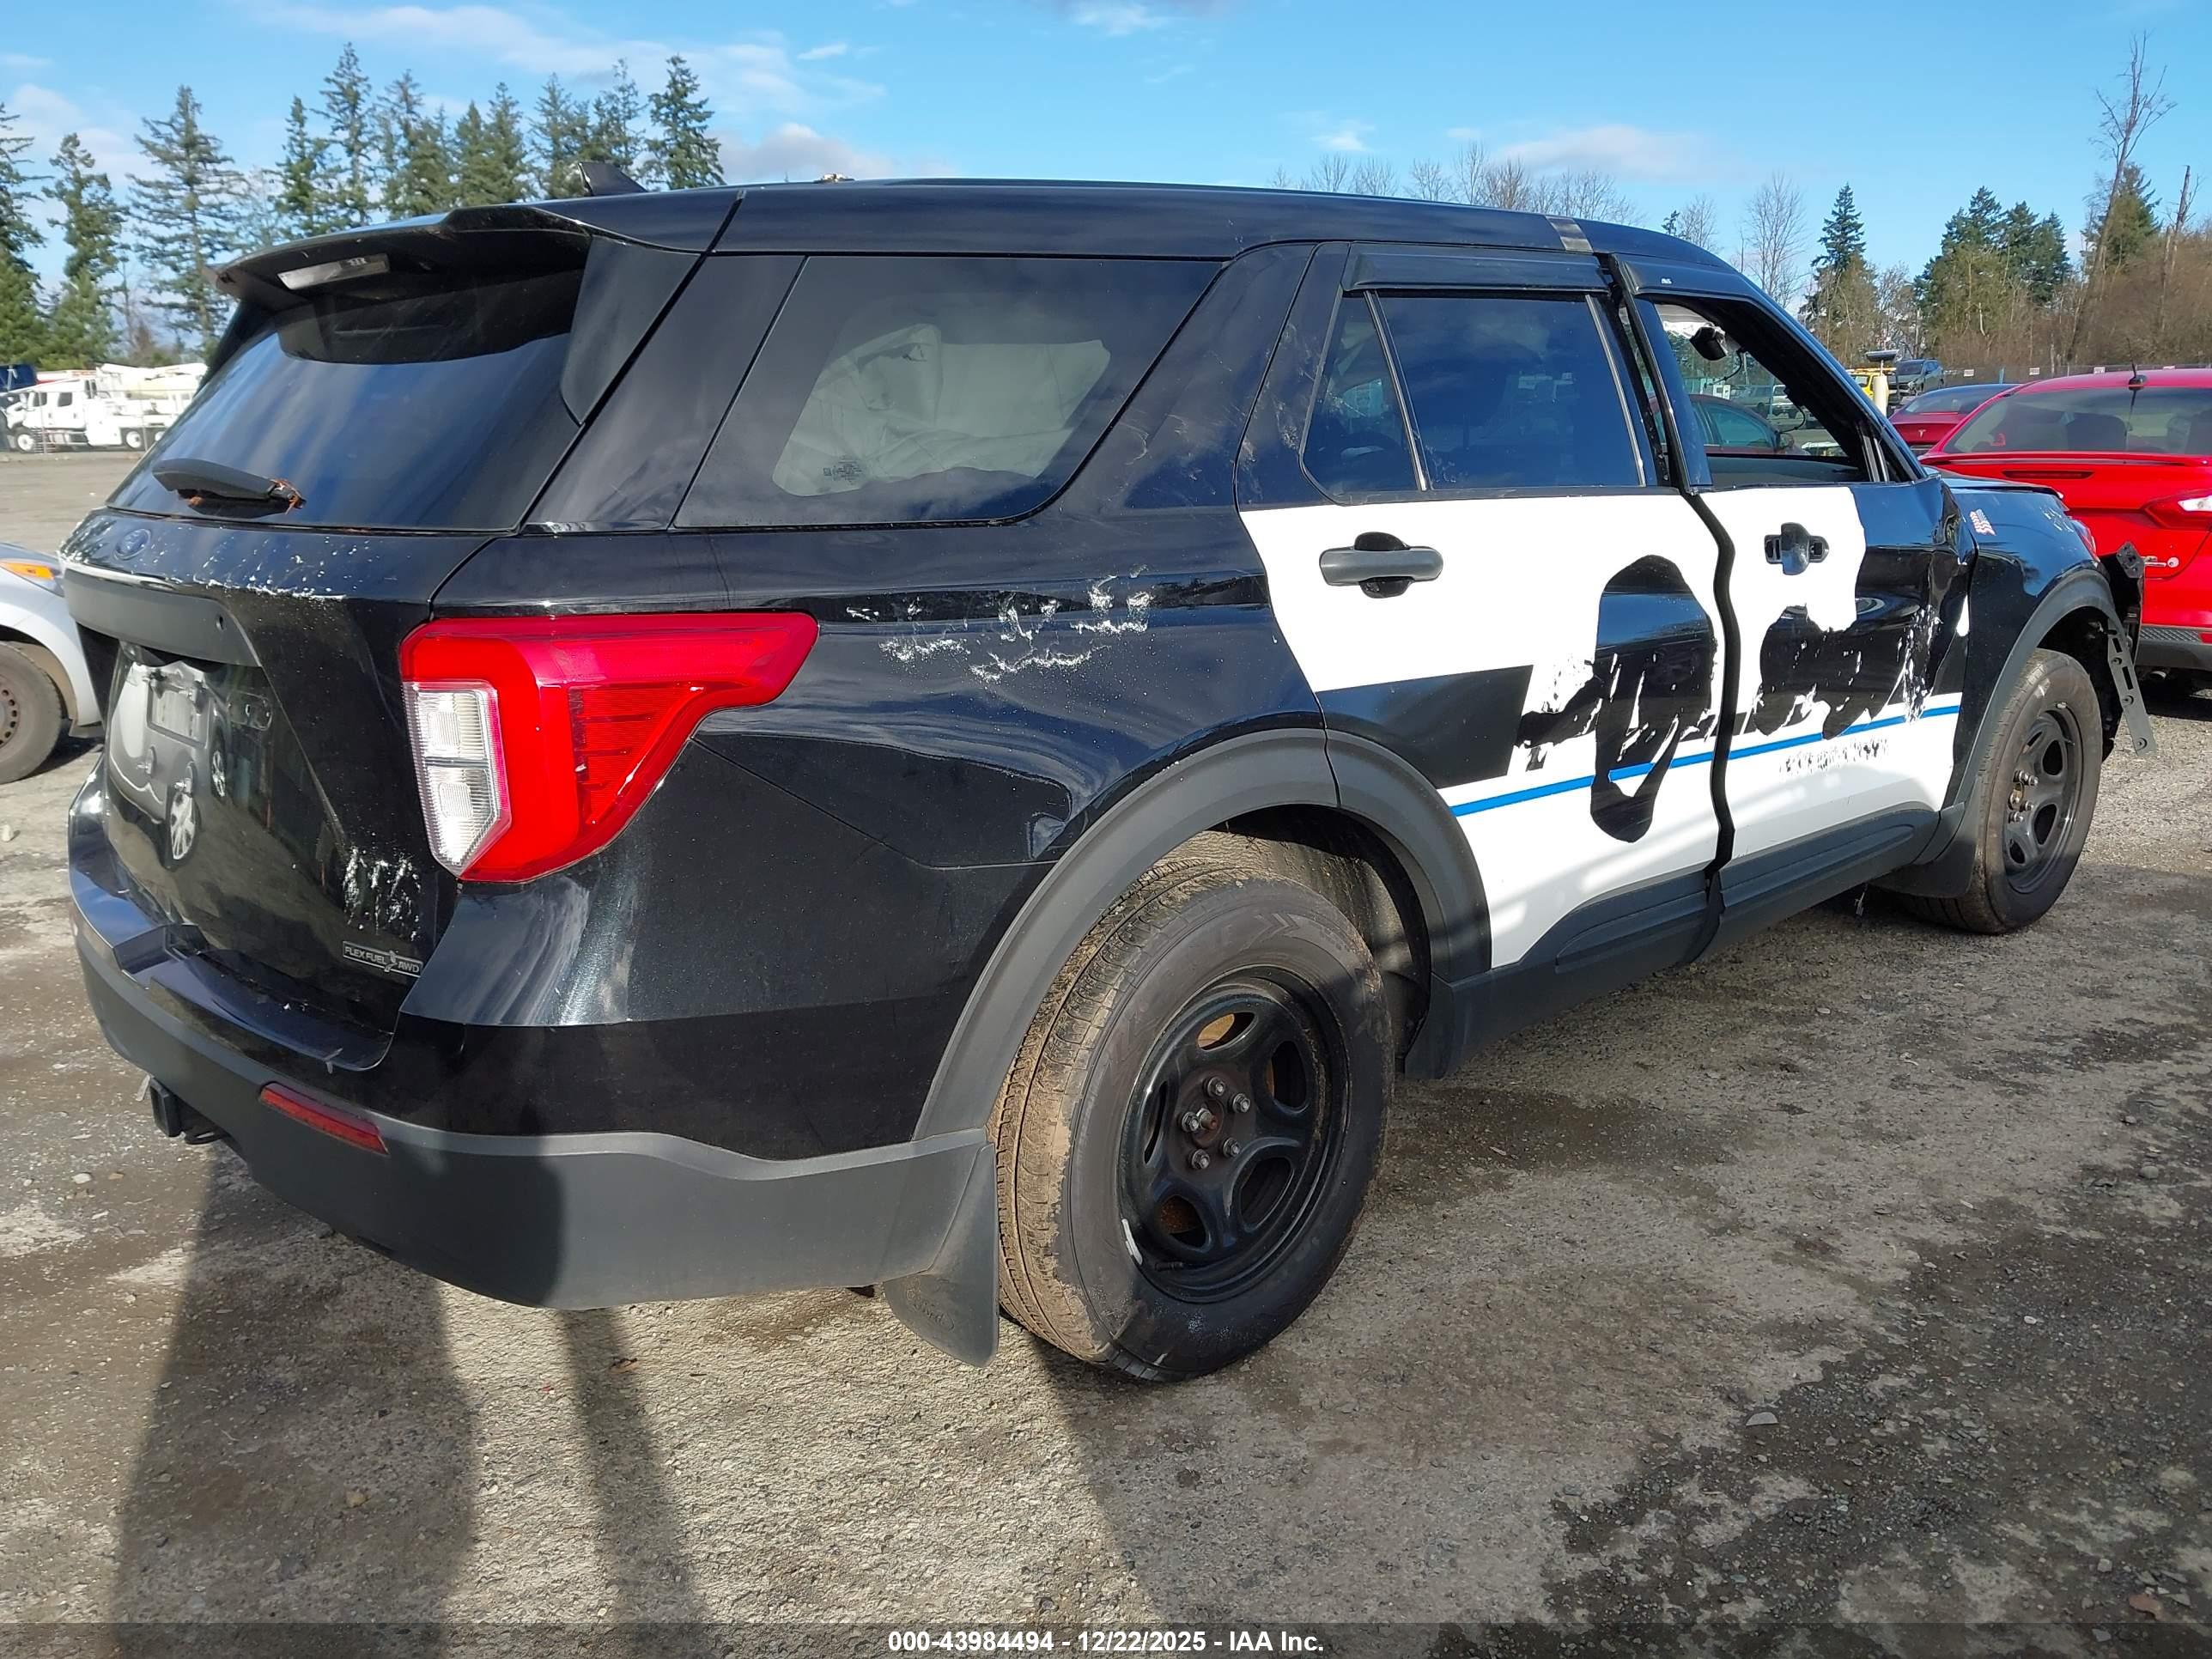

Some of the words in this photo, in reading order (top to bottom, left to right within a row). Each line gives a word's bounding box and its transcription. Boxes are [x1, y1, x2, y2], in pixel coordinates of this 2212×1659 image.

[344, 946, 365, 959] FLEX
[365, 951, 387, 965] FUEL
[398, 961, 420, 973] AWD
